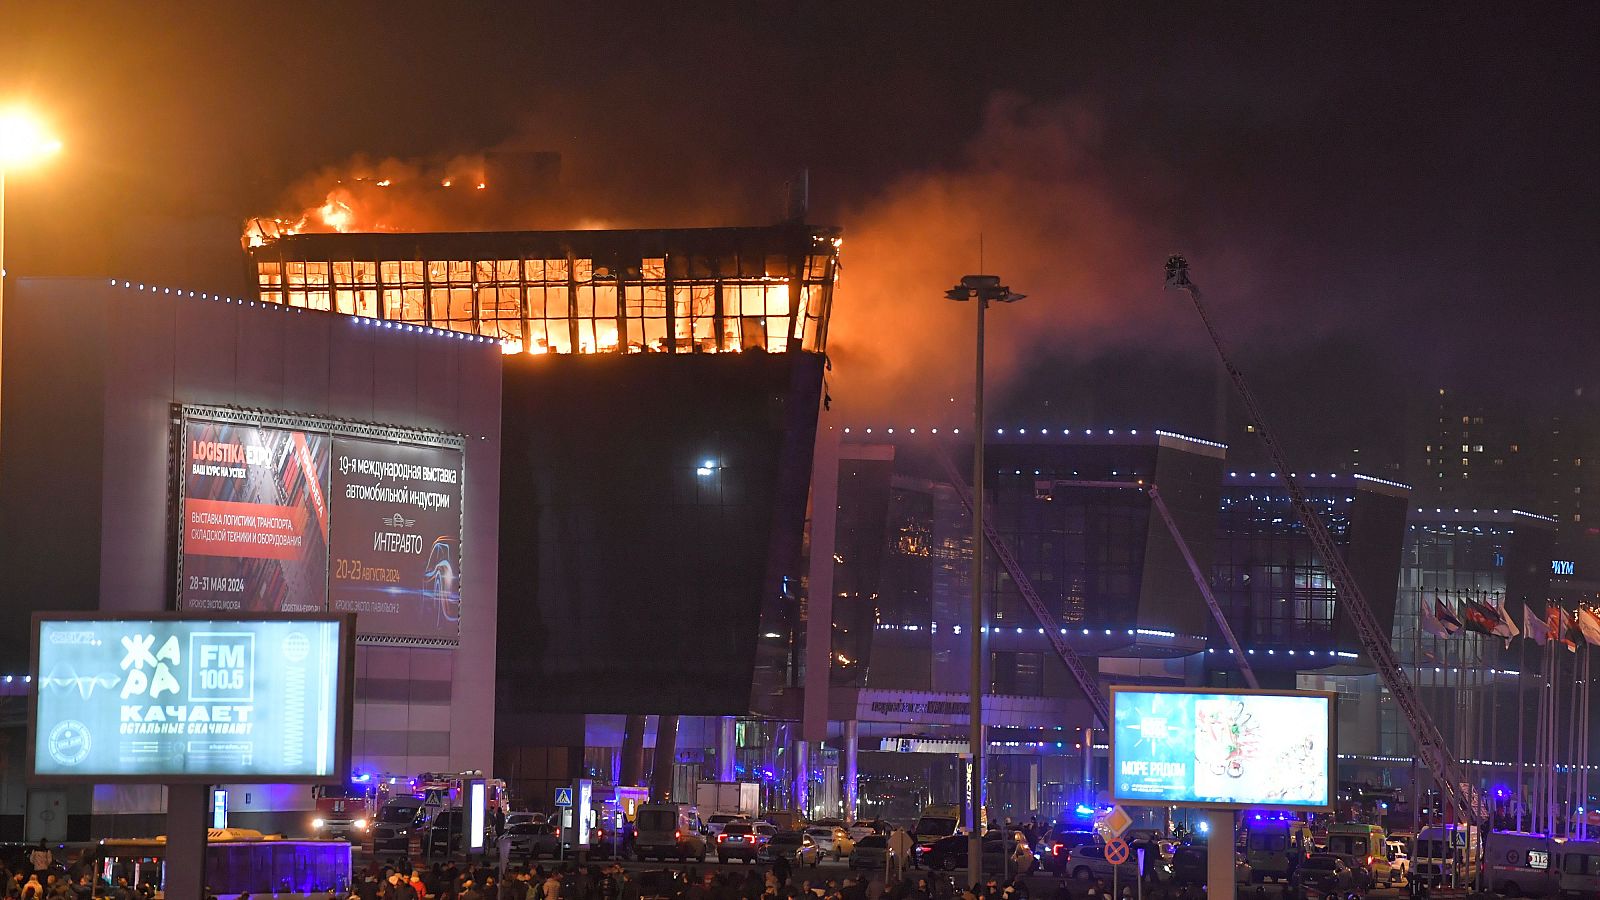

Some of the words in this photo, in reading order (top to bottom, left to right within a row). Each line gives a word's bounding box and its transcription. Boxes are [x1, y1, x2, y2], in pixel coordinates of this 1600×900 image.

[192, 440, 246, 463] LOGISTIKA
[192, 464, 205, 475] ВАШ
[206, 465, 220, 477] КУРС
[220, 467, 229, 477] НА
[229, 468, 247, 478] УСПЕХ
[338, 455, 357, 475] 19-я
[357, 459, 421, 481] международная
[422, 466, 457, 483] выставка
[345, 483, 408, 504] автомобильной
[409, 489, 450, 512] индустрии
[191, 512, 222, 525] ВЫСТАВКА
[223, 514, 256, 529] ЛОГИСТИКИ,
[191, 528, 226, 542] СКЛАДСКОЙ
[227, 531, 252, 544] ТЕХНИКИ
[252, 533, 257, 544] И
[257, 533, 302, 547] ОБОРУДОВАНИЯ
[373, 531, 423, 554] ИНТЕРАВТО
[336, 559, 361, 579] 20-23
[361, 567, 386, 581] АВГУСТА
[385, 568, 401, 583] 2024
[189, 575, 210, 591] 28-31
[210, 577, 227, 591] МАЯ
[227, 578, 245, 592] 2024
[200, 644, 245, 668] FM
[200, 668, 245, 690] 100.5
[120, 704, 254, 722] КАЧАЕТ
[119, 722, 185, 735] ОСТАЛЬНЫЕ
[187, 722, 254, 735] СКАЧИВАЮТ
[1121, 760, 1149, 776] МОРЕ
